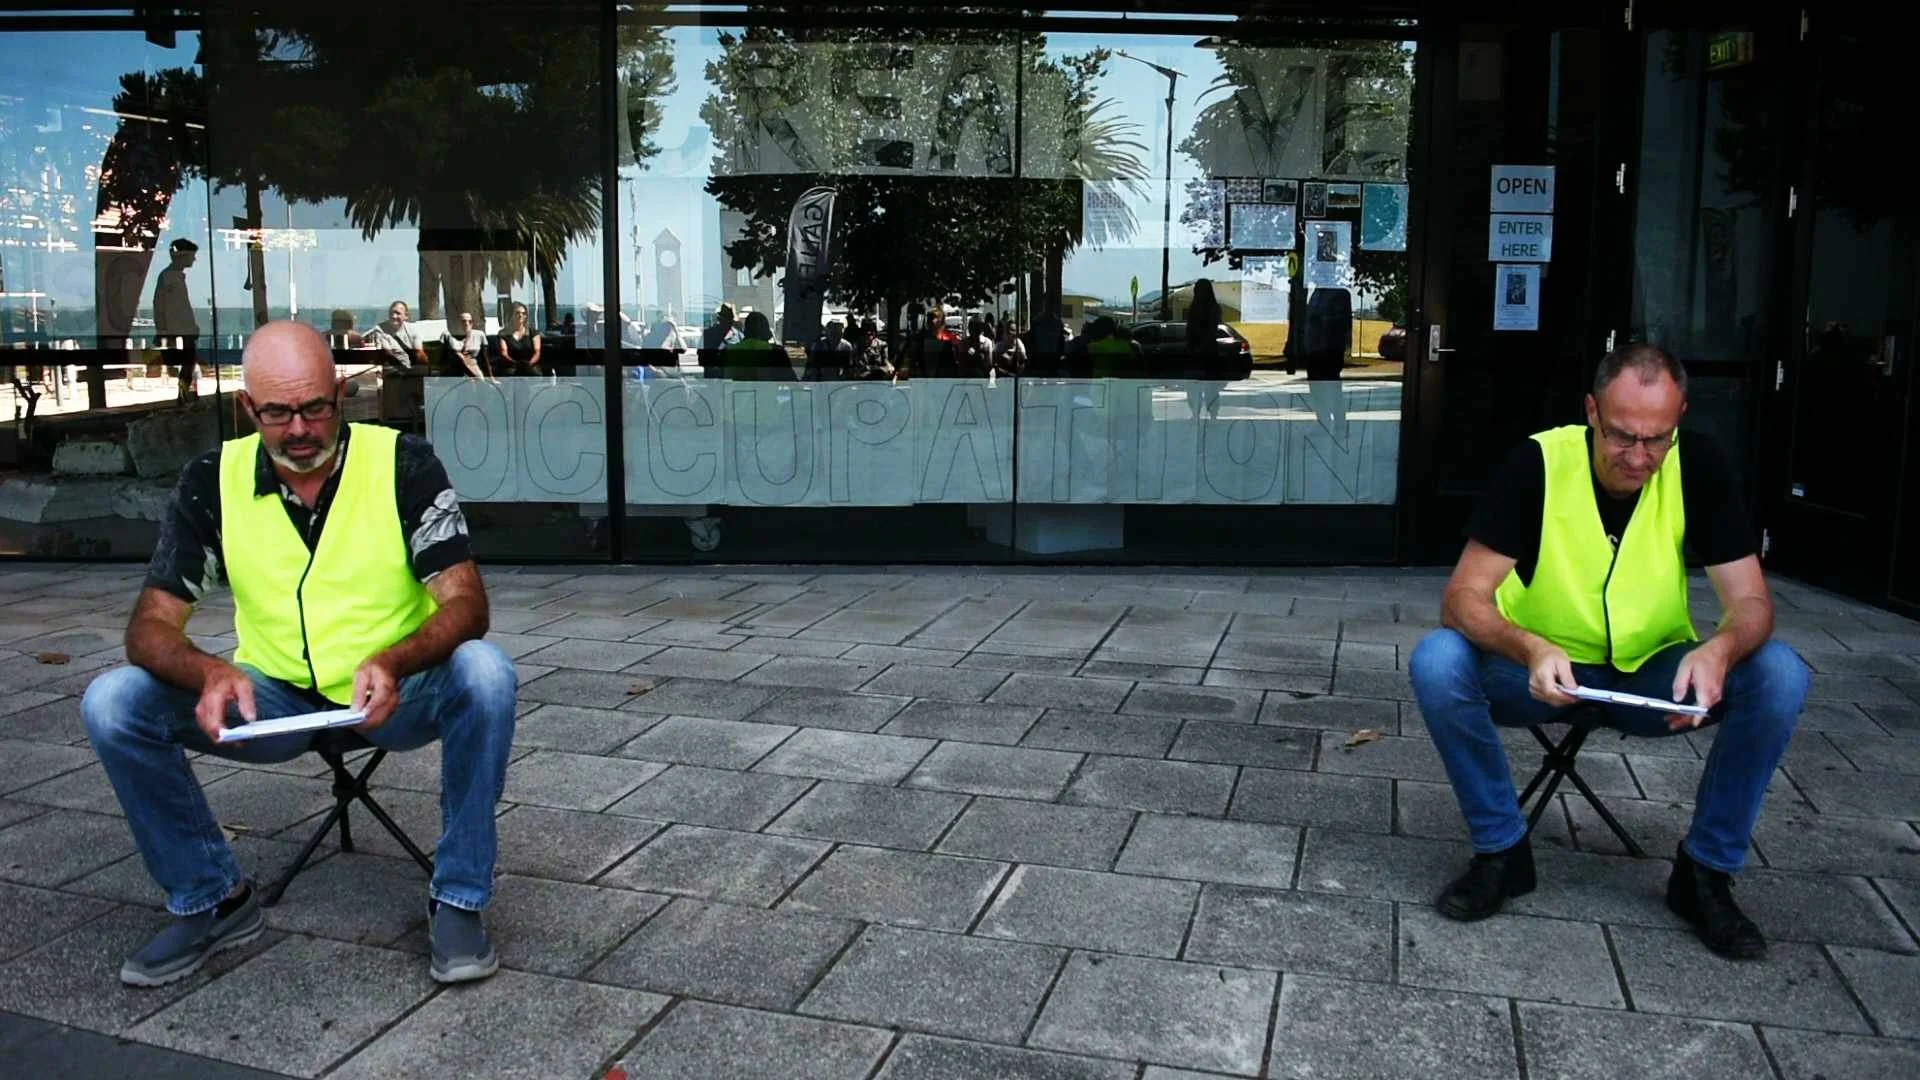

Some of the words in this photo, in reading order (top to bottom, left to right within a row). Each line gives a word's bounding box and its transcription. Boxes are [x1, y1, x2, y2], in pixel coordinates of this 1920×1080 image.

[1496, 177, 1547, 195] OPEN
[1498, 221, 1544, 235] ENTER
[1501, 243, 1539, 257] HERE
[432, 378, 1373, 505] OCCUPATION
